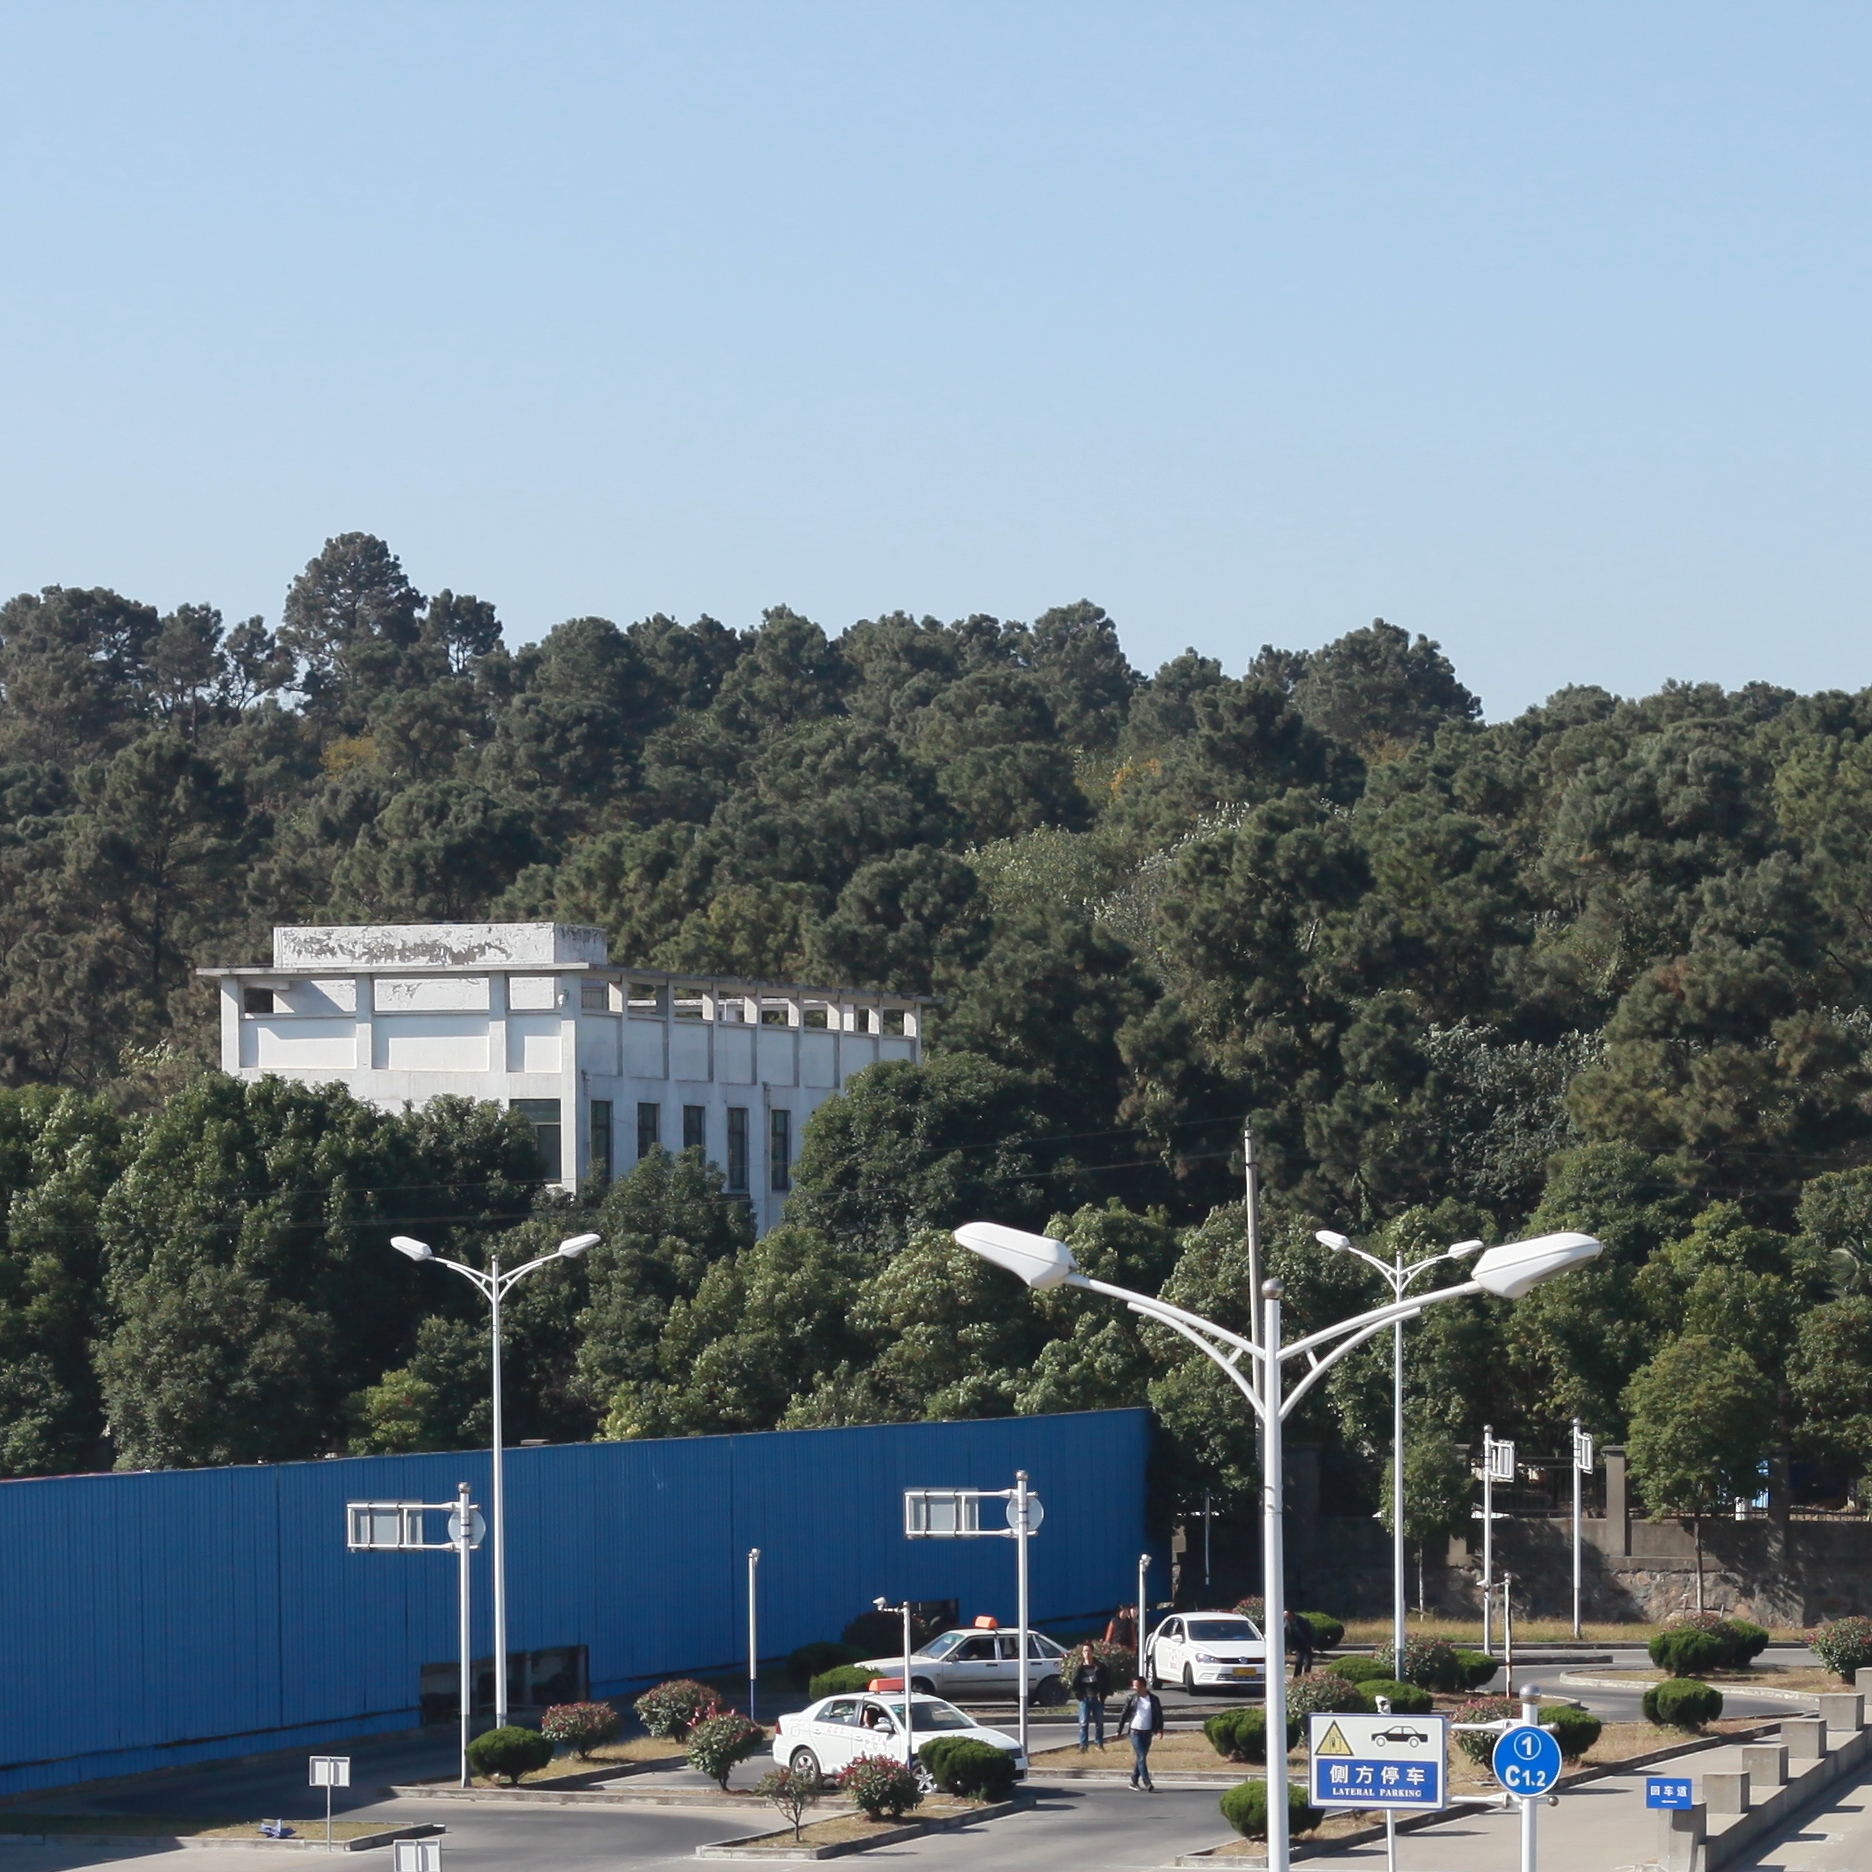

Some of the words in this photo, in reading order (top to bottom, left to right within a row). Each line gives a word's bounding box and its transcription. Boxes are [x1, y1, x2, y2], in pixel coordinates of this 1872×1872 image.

[1329, 1763, 1425, 1787] 侧方停车
[1504, 1765, 1547, 1789] C1.2
[1331, 1786, 1376, 1798] LATERAL
[1379, 1787, 1422, 1799] PARKING
[1650, 1785, 1688, 1798] 回车道
